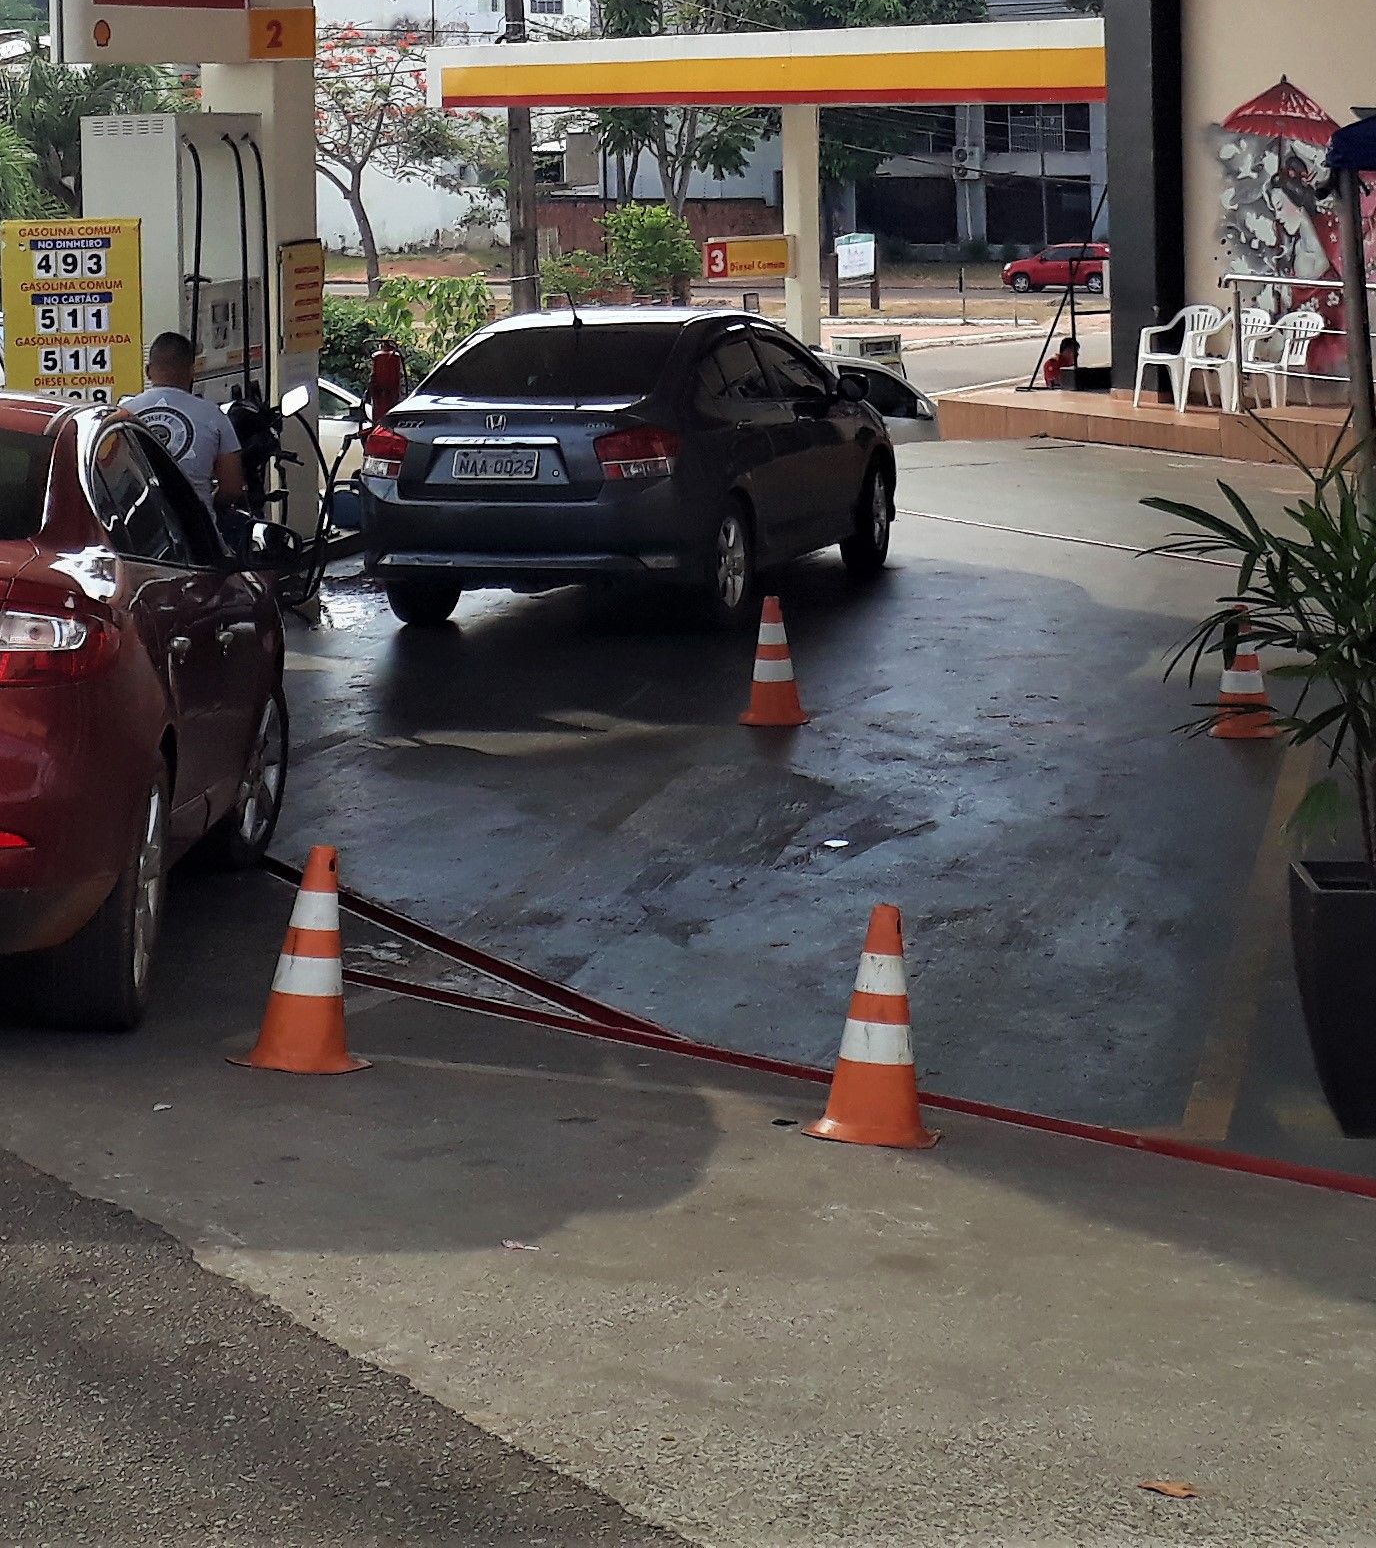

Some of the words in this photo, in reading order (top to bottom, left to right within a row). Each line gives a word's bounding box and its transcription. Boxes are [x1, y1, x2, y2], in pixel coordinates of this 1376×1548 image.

[266, 20, 283, 49] 2
[19, 227, 74, 237] GASOLINA
[78, 226, 121, 236] COMUM
[38, 241, 53, 249] NO
[56, 239, 102, 248] DINHEIRO
[710, 249, 724, 273] 3
[730, 261, 755, 272] Diesel
[21, 282, 75, 291] GASOLINA
[79, 280, 123, 290] COMUM
[44, 296, 59, 304] NO
[61, 294, 100, 303] CARTÃO
[15, 337, 70, 347] GASOLINA
[73, 335, 131, 345] ADITIVADA
[34, 377, 69, 387] DIESEL
[71, 376, 115, 386] COMUM
